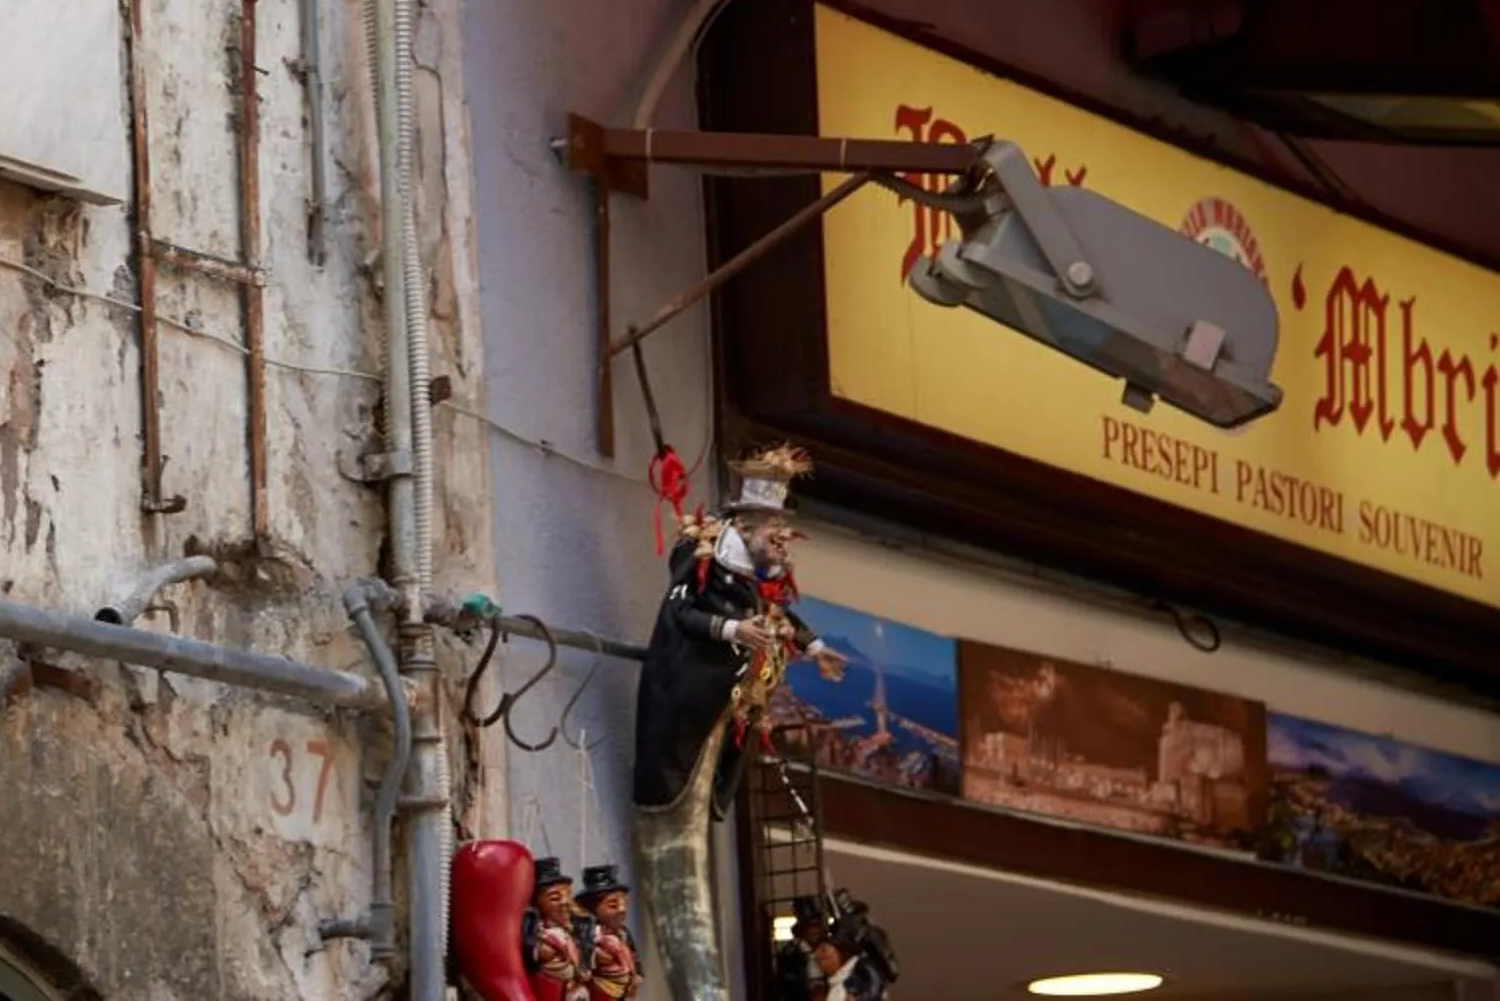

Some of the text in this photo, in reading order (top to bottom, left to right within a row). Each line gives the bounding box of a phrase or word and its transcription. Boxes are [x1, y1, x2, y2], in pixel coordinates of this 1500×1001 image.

[1101, 415, 1484, 581] PRESEPI PASTORI SOUVENIR
[269, 738, 334, 824] 37
